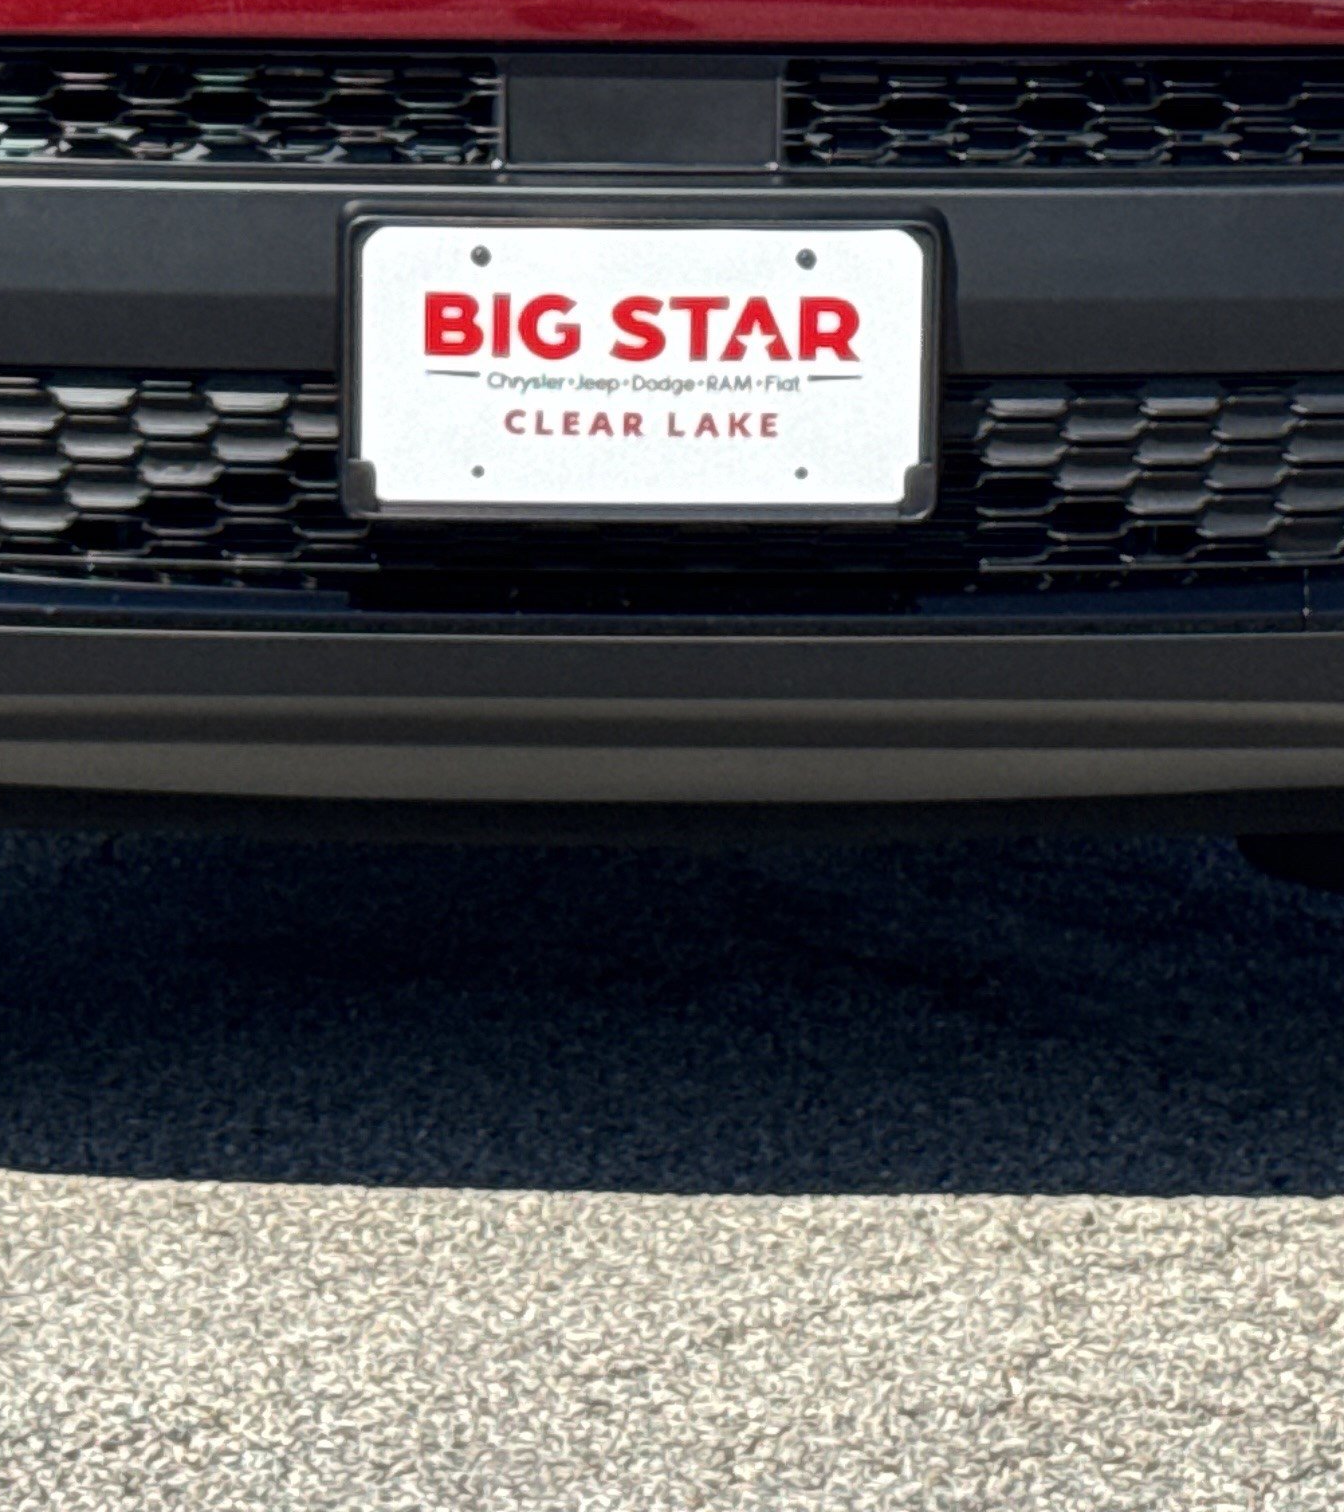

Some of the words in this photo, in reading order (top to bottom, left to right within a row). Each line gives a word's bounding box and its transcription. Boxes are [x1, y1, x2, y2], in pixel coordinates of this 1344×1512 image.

[424, 291, 581, 360] BIG
[609, 295, 861, 363] STAR
[504, 409, 644, 437] CLEAR
[667, 411, 779, 438] LAKE
